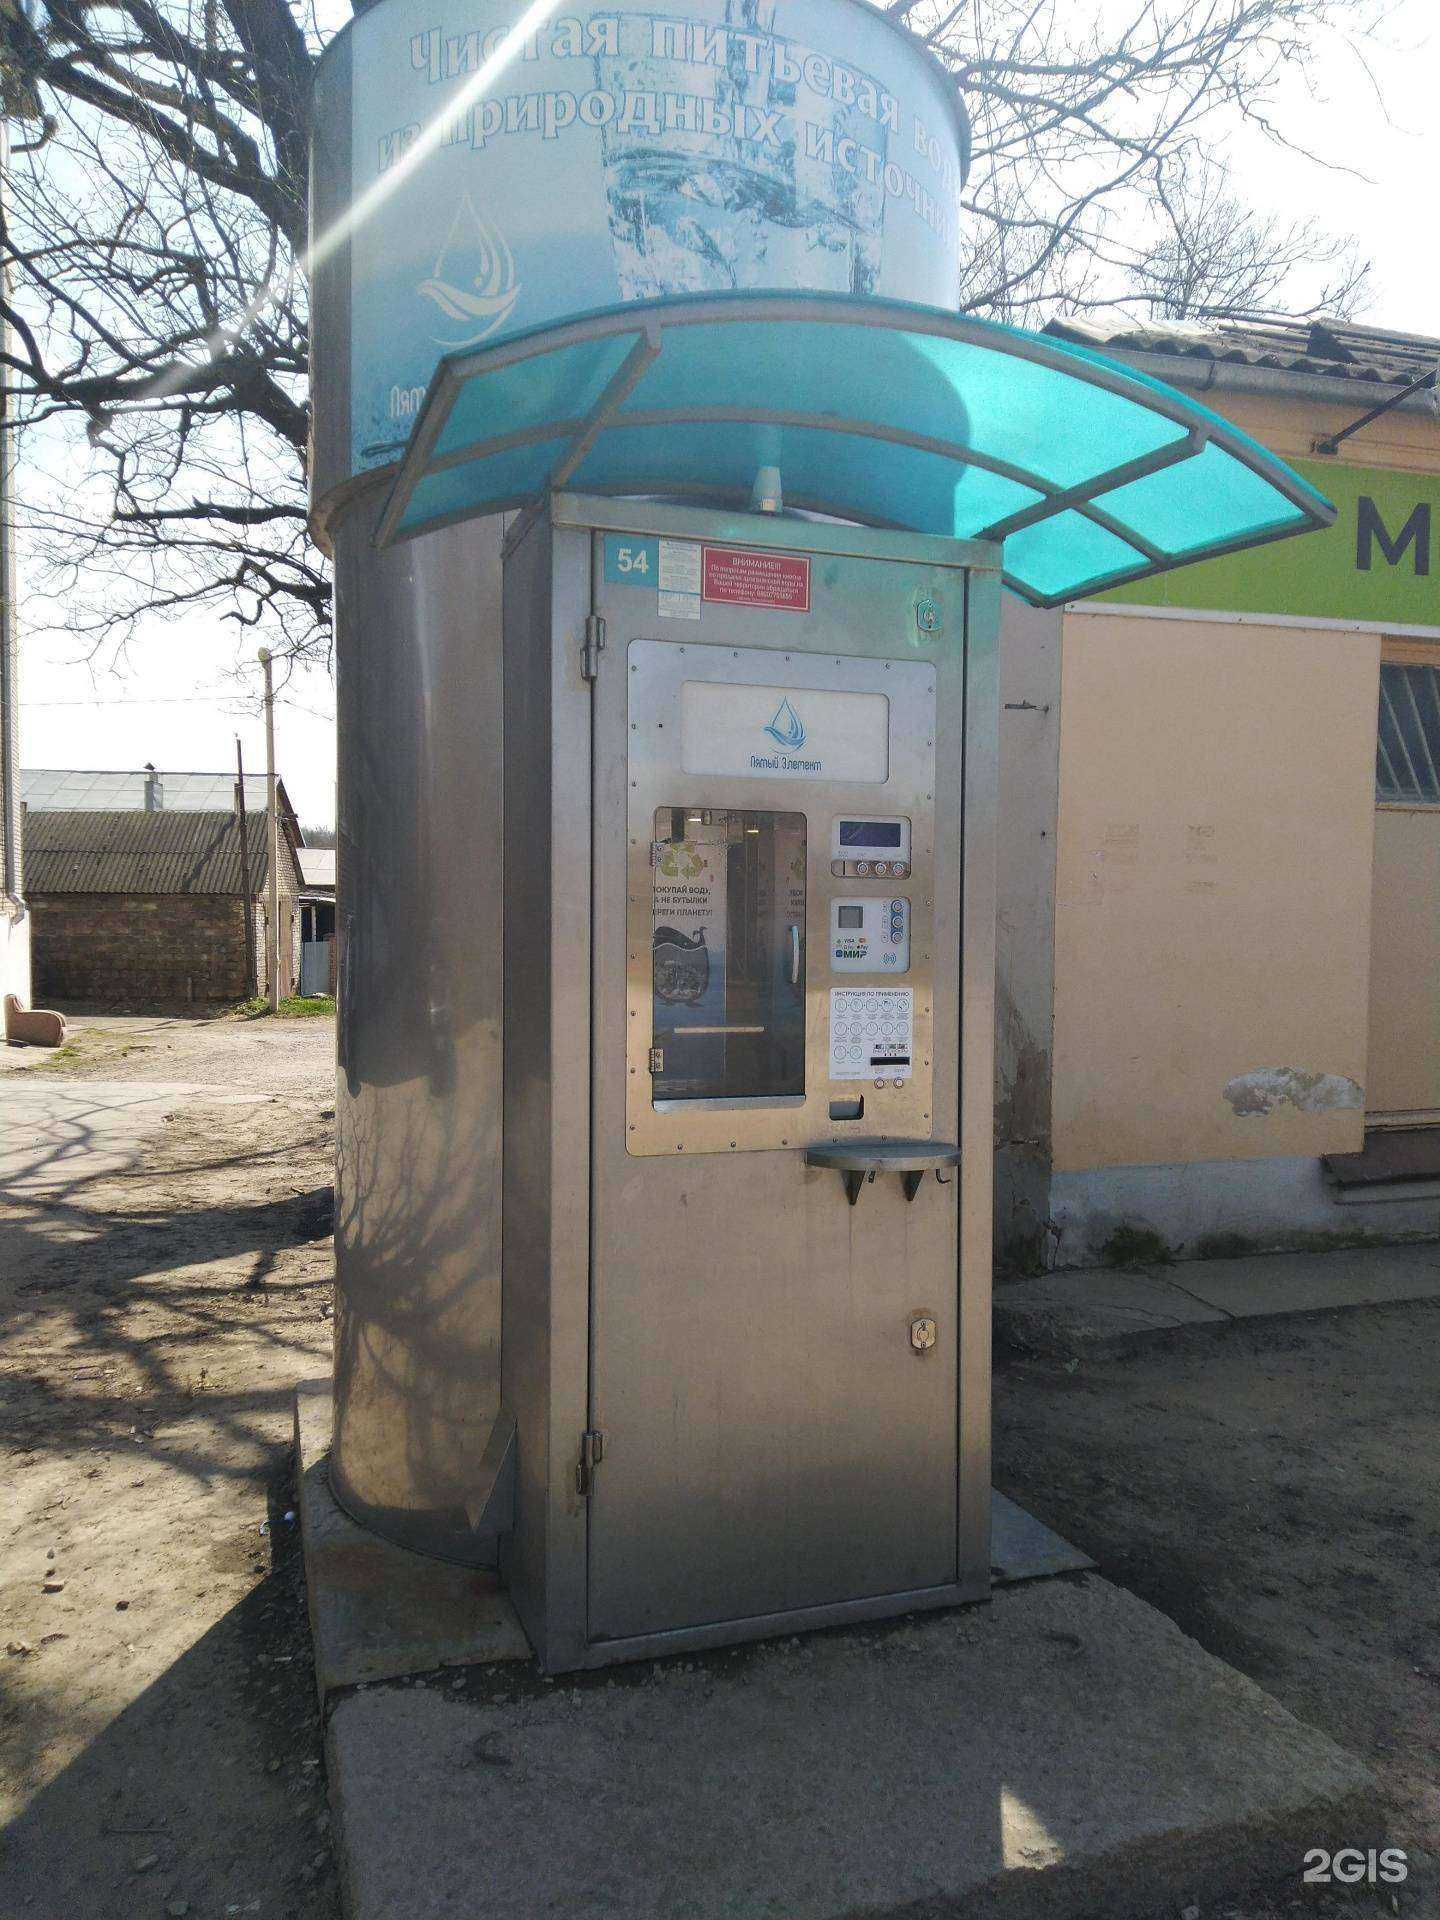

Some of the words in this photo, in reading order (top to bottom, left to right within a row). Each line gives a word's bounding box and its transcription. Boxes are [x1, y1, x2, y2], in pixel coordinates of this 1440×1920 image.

[409, 17, 622, 84] Чистая
[652, 17, 899, 134] питьевая
[913, 113, 955, 192] вод
[439, 90, 786, 149] природных
[804, 120, 952, 247] источни
[389, 384, 428, 418] Пят
[1356, 495, 1431, 576] М
[617, 547, 649, 575] 54
[732, 557, 781, 571] ВНИМАНИЕ!!!
[751, 755, 779, 769] Пятый
[781, 757, 822, 771] Элемент
[672, 896, 708, 904] БУТЫЛКИ
[844, 950, 867, 959] МИР
